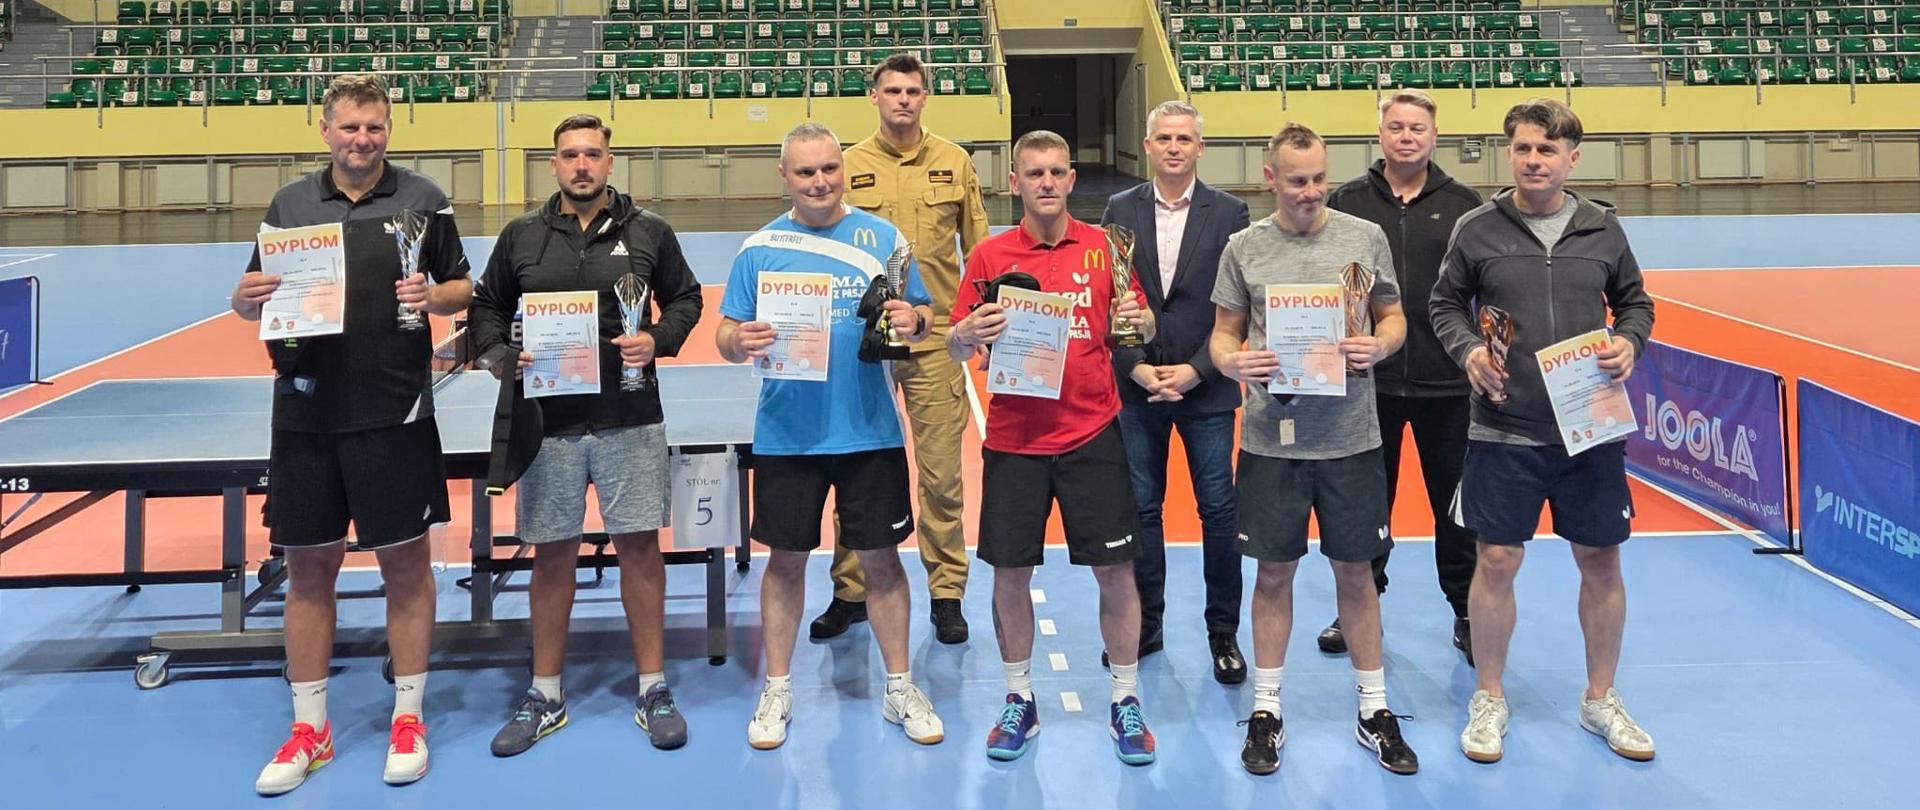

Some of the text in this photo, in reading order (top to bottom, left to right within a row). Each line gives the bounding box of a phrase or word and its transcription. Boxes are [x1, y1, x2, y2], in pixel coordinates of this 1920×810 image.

[263, 234, 339, 256] DYPLOM
[761, 282, 828, 297] DYPLOM
[526, 302, 593, 316] DYPLOM
[1000, 296, 1068, 319] DYPLOM
[1269, 295, 1339, 309] DYPLOM
[1542, 340, 1608, 373] DYPLOM
[0, 478, 30, 491] -13
[1656, 453, 1781, 517] for the Champion in you!
[695, 497, 713, 526] 5
